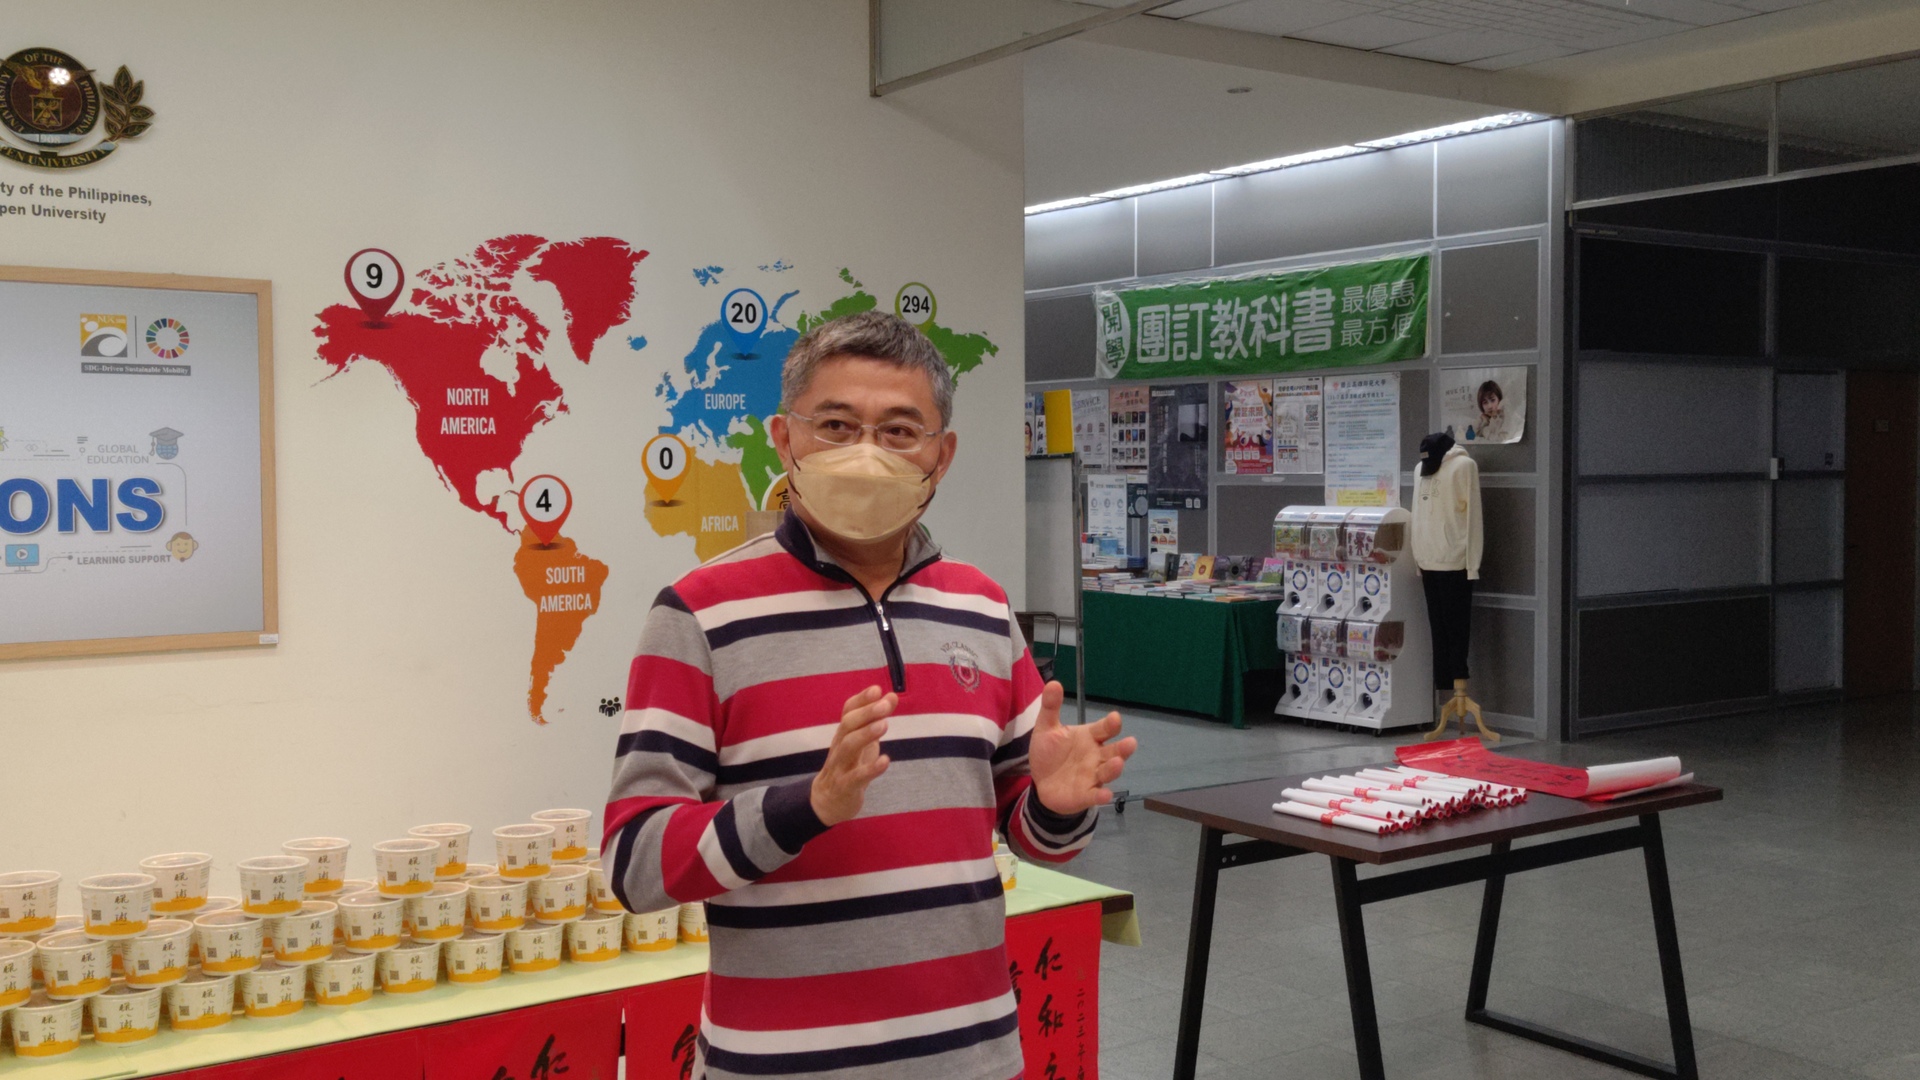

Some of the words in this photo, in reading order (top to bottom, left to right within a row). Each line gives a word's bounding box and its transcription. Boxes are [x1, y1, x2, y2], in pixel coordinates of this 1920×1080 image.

[24, 53, 39, 63] OF
[42, 53, 65, 65] THE
[19, 183, 34, 195] of
[39, 184, 64, 198] the
[68, 186, 152, 206] Philippines,
[31, 204, 106, 223] University
[365, 263, 383, 289] 9
[902, 295, 931, 313] 294
[1341, 279, 1415, 314] 最優惠
[731, 302, 757, 324] 20
[1102, 302, 1125, 368] 開學
[1136, 287, 1336, 364] 團訂教科書
[1341, 311, 1415, 347] 最方便
[125, 365, 160, 374] Sustainable
[162, 366, 189, 375] Mobility
[446, 388, 489, 406] NORTH
[704, 394, 746, 410] EUROPE
[440, 417, 497, 435] AMERICA
[97, 444, 138, 454] GLOBAL
[658, 447, 674, 470] 0
[87, 455, 149, 464] EDUCATION
[0, 476, 165, 536] ONS
[535, 489, 552, 512] 4
[701, 515, 739, 533] AFRICA
[77, 555, 126, 565] LEARNING
[128, 554, 171, 564] SUPPORT
[545, 566, 585, 585] SOUTH
[539, 594, 592, 613] AMERICA
